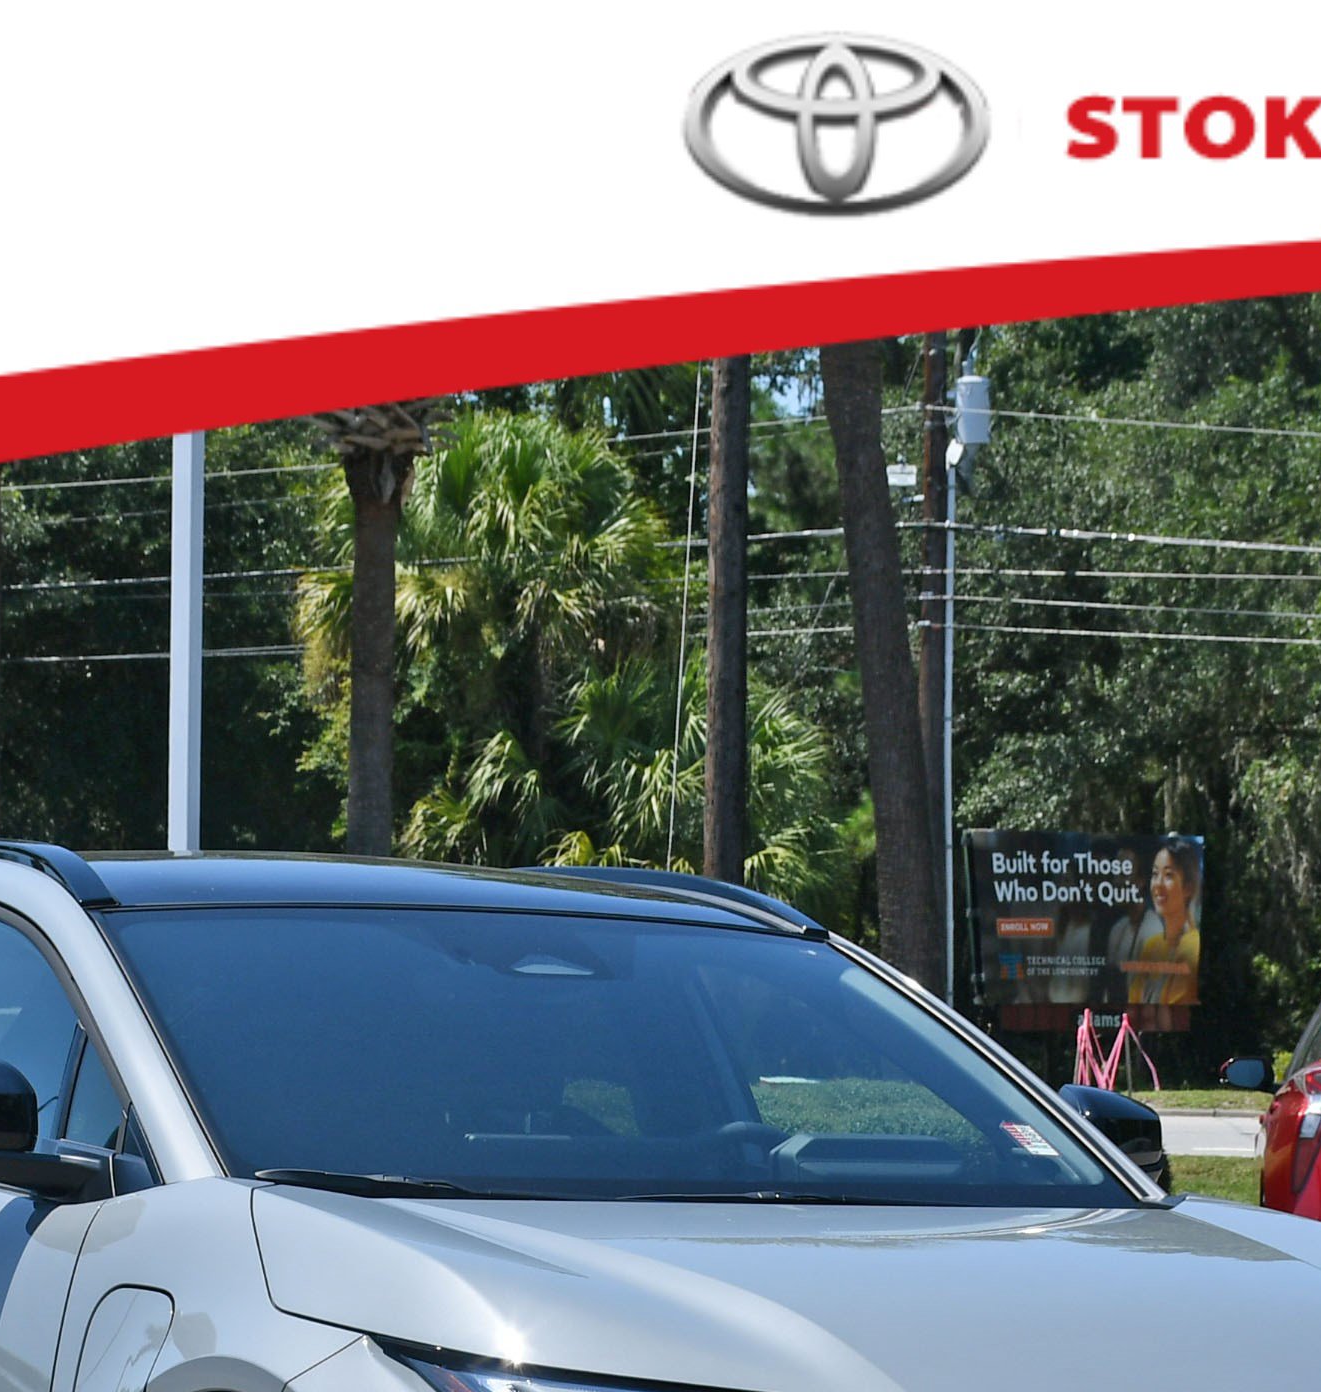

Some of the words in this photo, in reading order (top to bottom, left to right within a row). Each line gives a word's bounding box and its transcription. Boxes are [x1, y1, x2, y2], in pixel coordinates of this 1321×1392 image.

[991, 850, 1037, 874] Built
[1041, 850, 1069, 874] for
[1073, 853, 1133, 875] Those
[993, 879, 1038, 902] Who
[1042, 881, 1093, 902] Don't
[1098, 881, 1144, 906] Quit.
[1026, 956, 1072, 966] TECHNICAL
